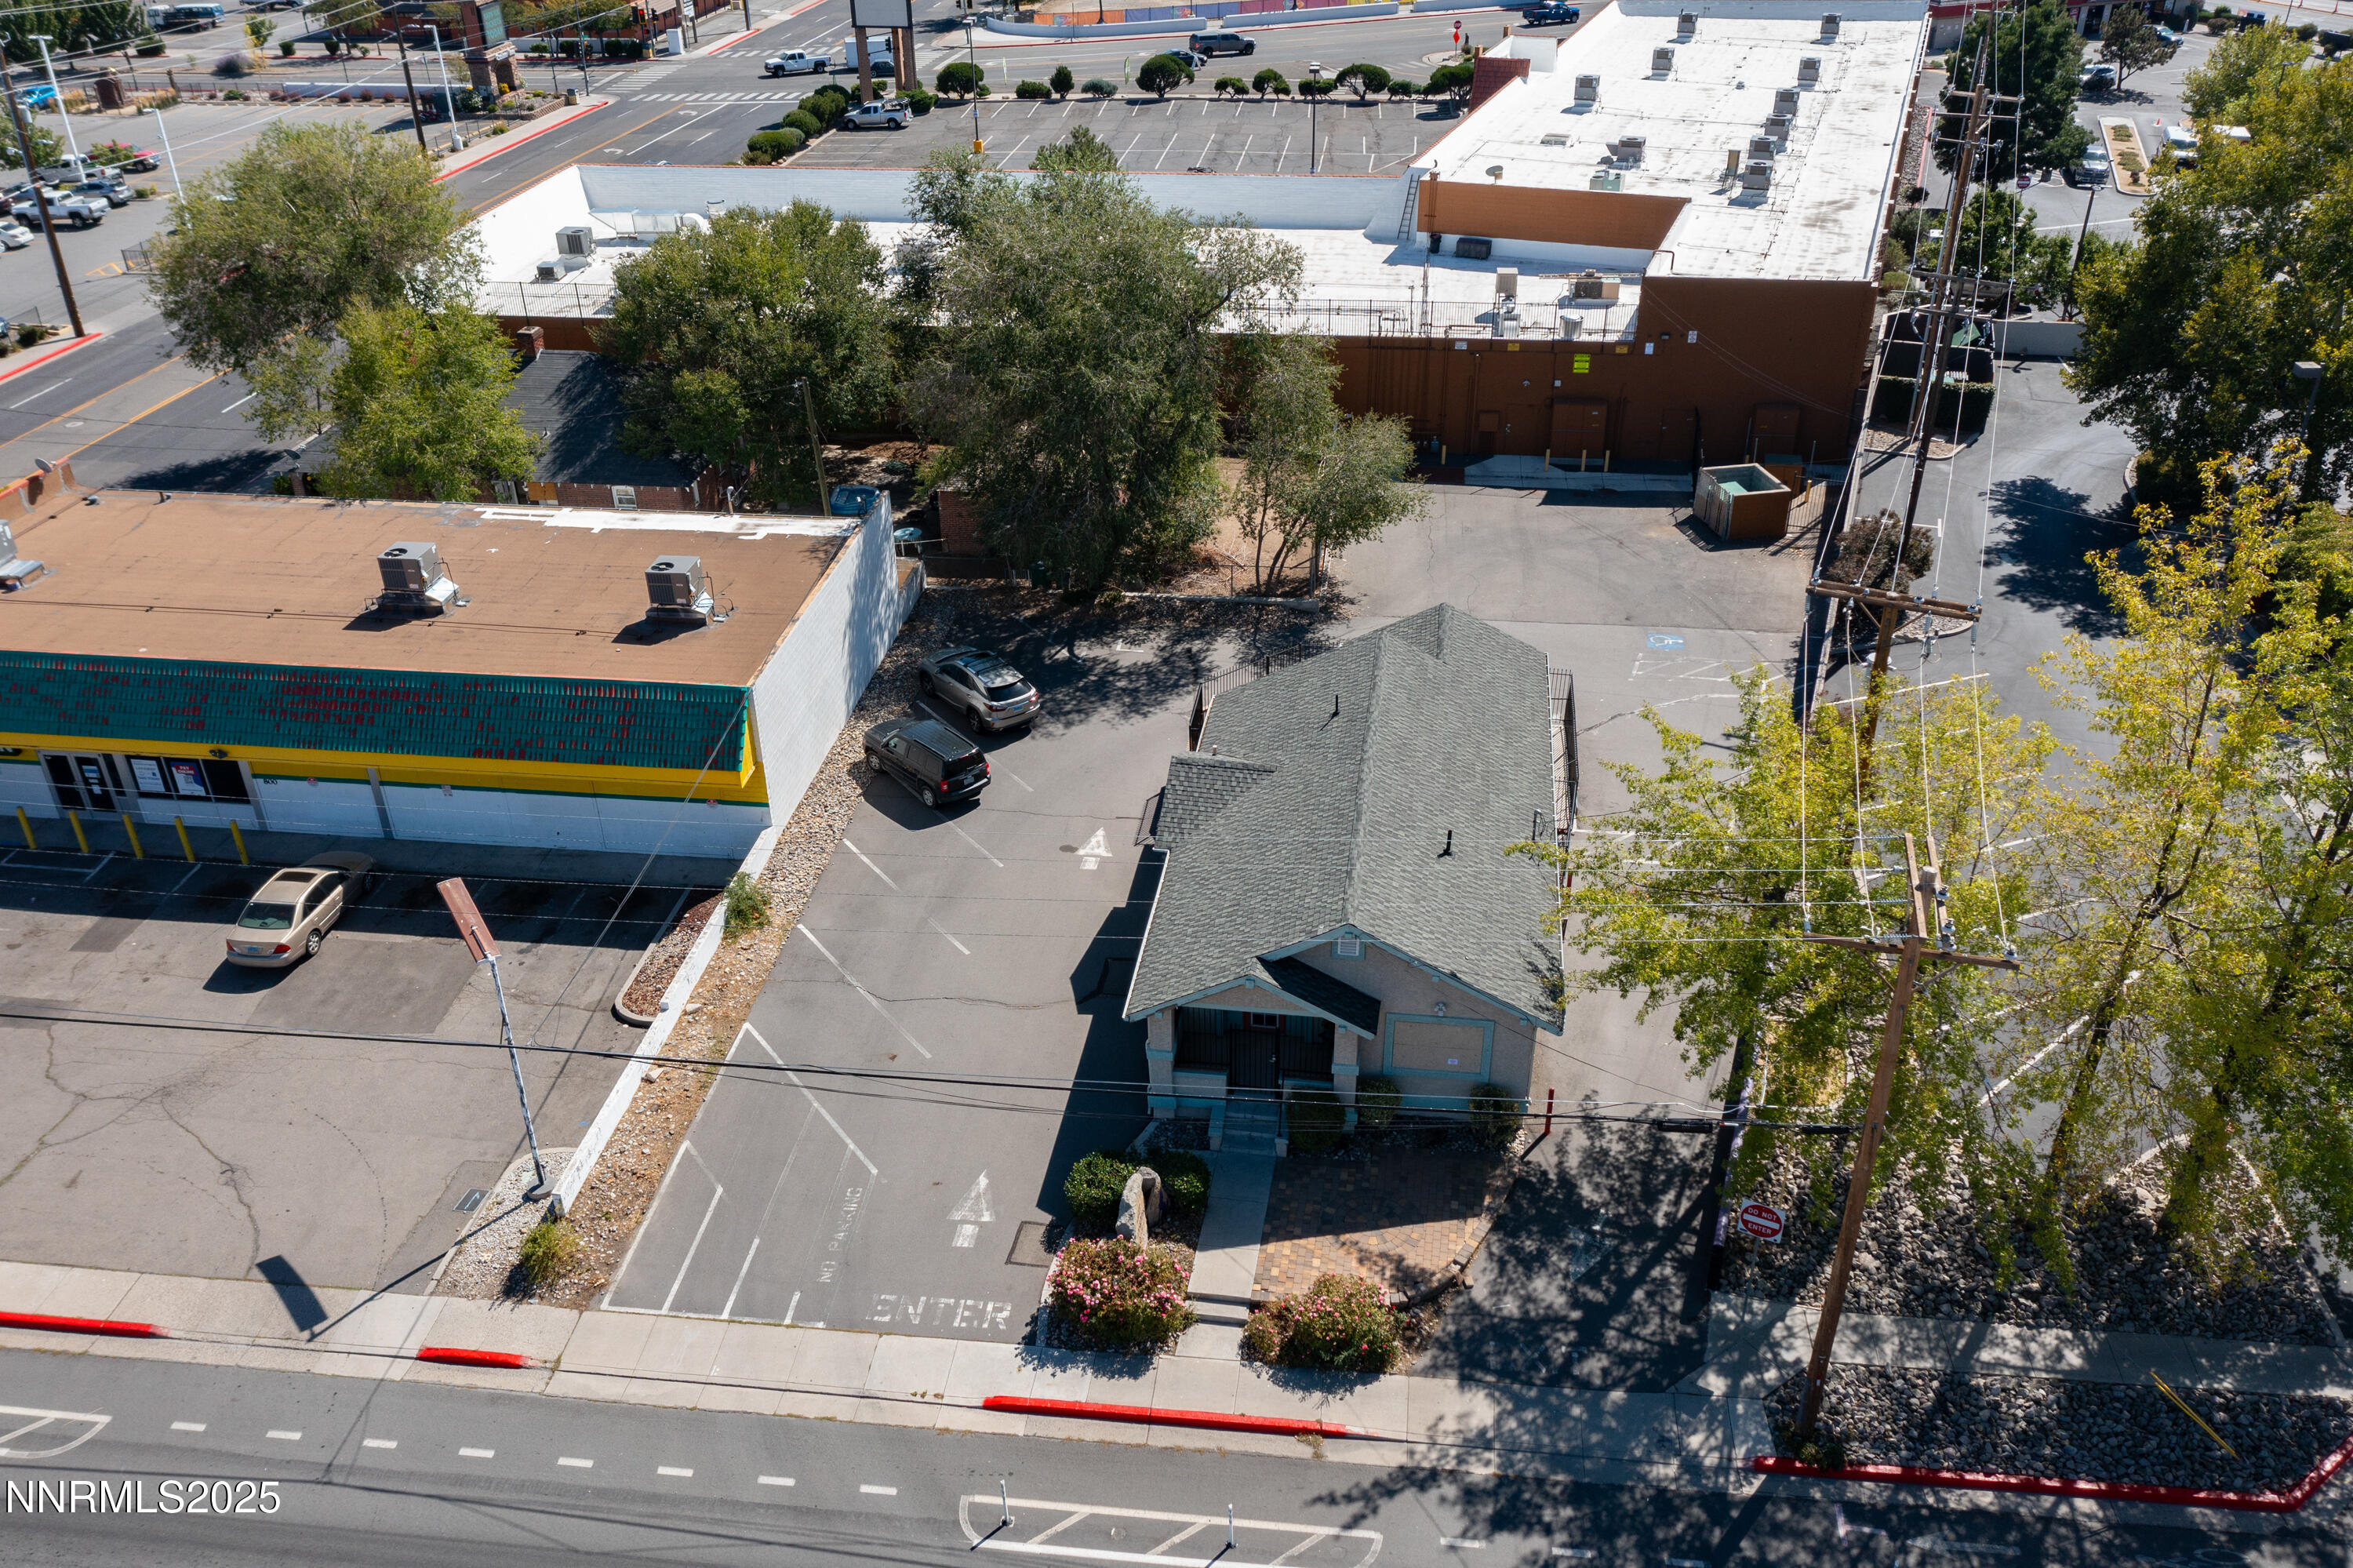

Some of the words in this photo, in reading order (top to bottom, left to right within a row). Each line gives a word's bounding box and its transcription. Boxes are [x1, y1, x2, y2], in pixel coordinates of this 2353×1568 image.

[1747, 1222, 1773, 1235] ENTER
[1762, 1211, 1777, 1221] NOT
[816, 1261, 837, 1282] NO
[828, 1187, 863, 1251] PARKING
[865, 1293, 1012, 1330] ENTER
